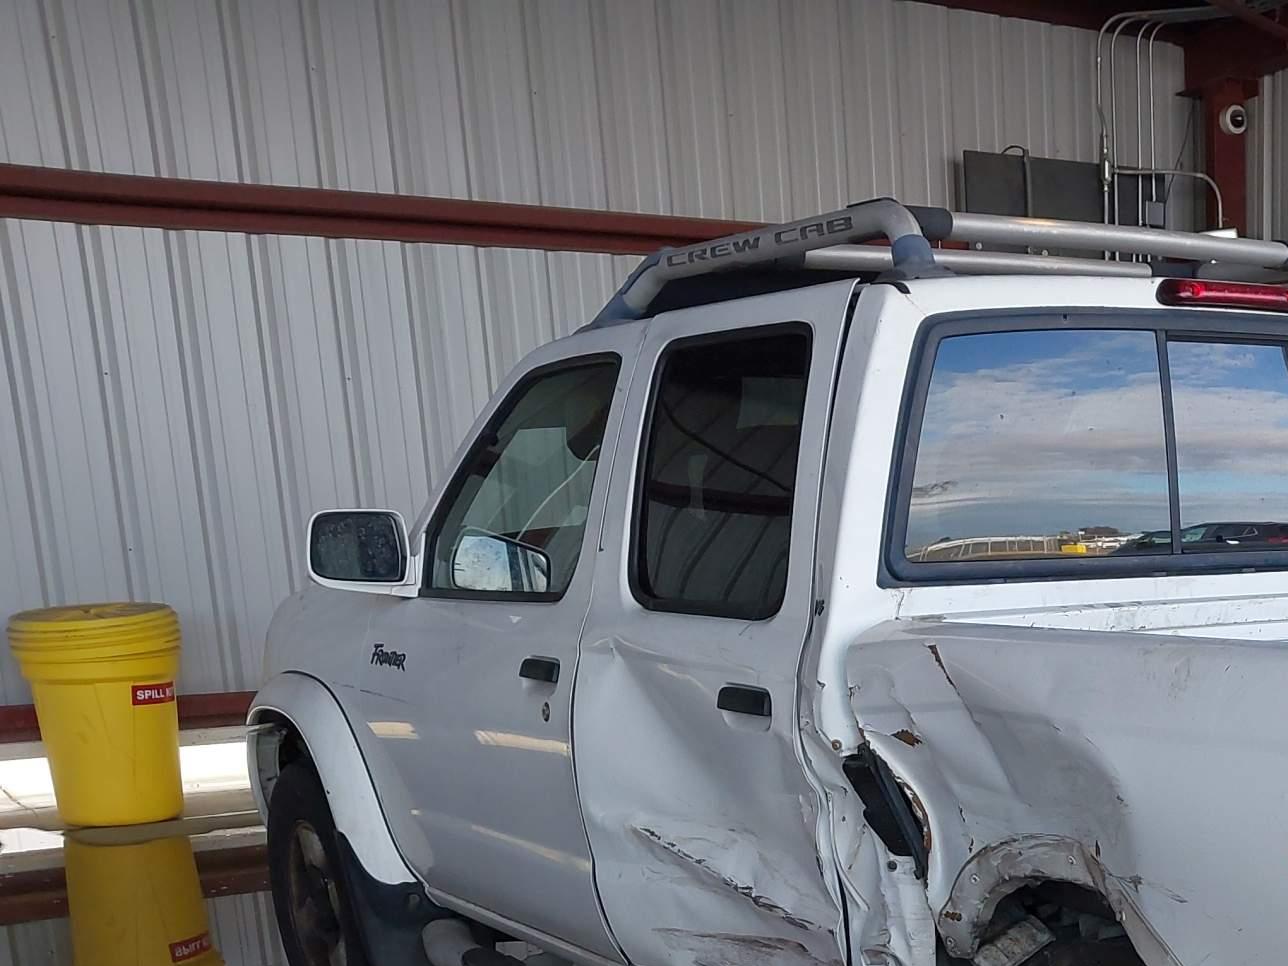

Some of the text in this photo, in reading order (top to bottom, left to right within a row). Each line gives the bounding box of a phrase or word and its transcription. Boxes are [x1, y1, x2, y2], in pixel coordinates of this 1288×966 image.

[667, 216, 853, 267] CREW CAB
[136, 688, 165, 700] SPILL
